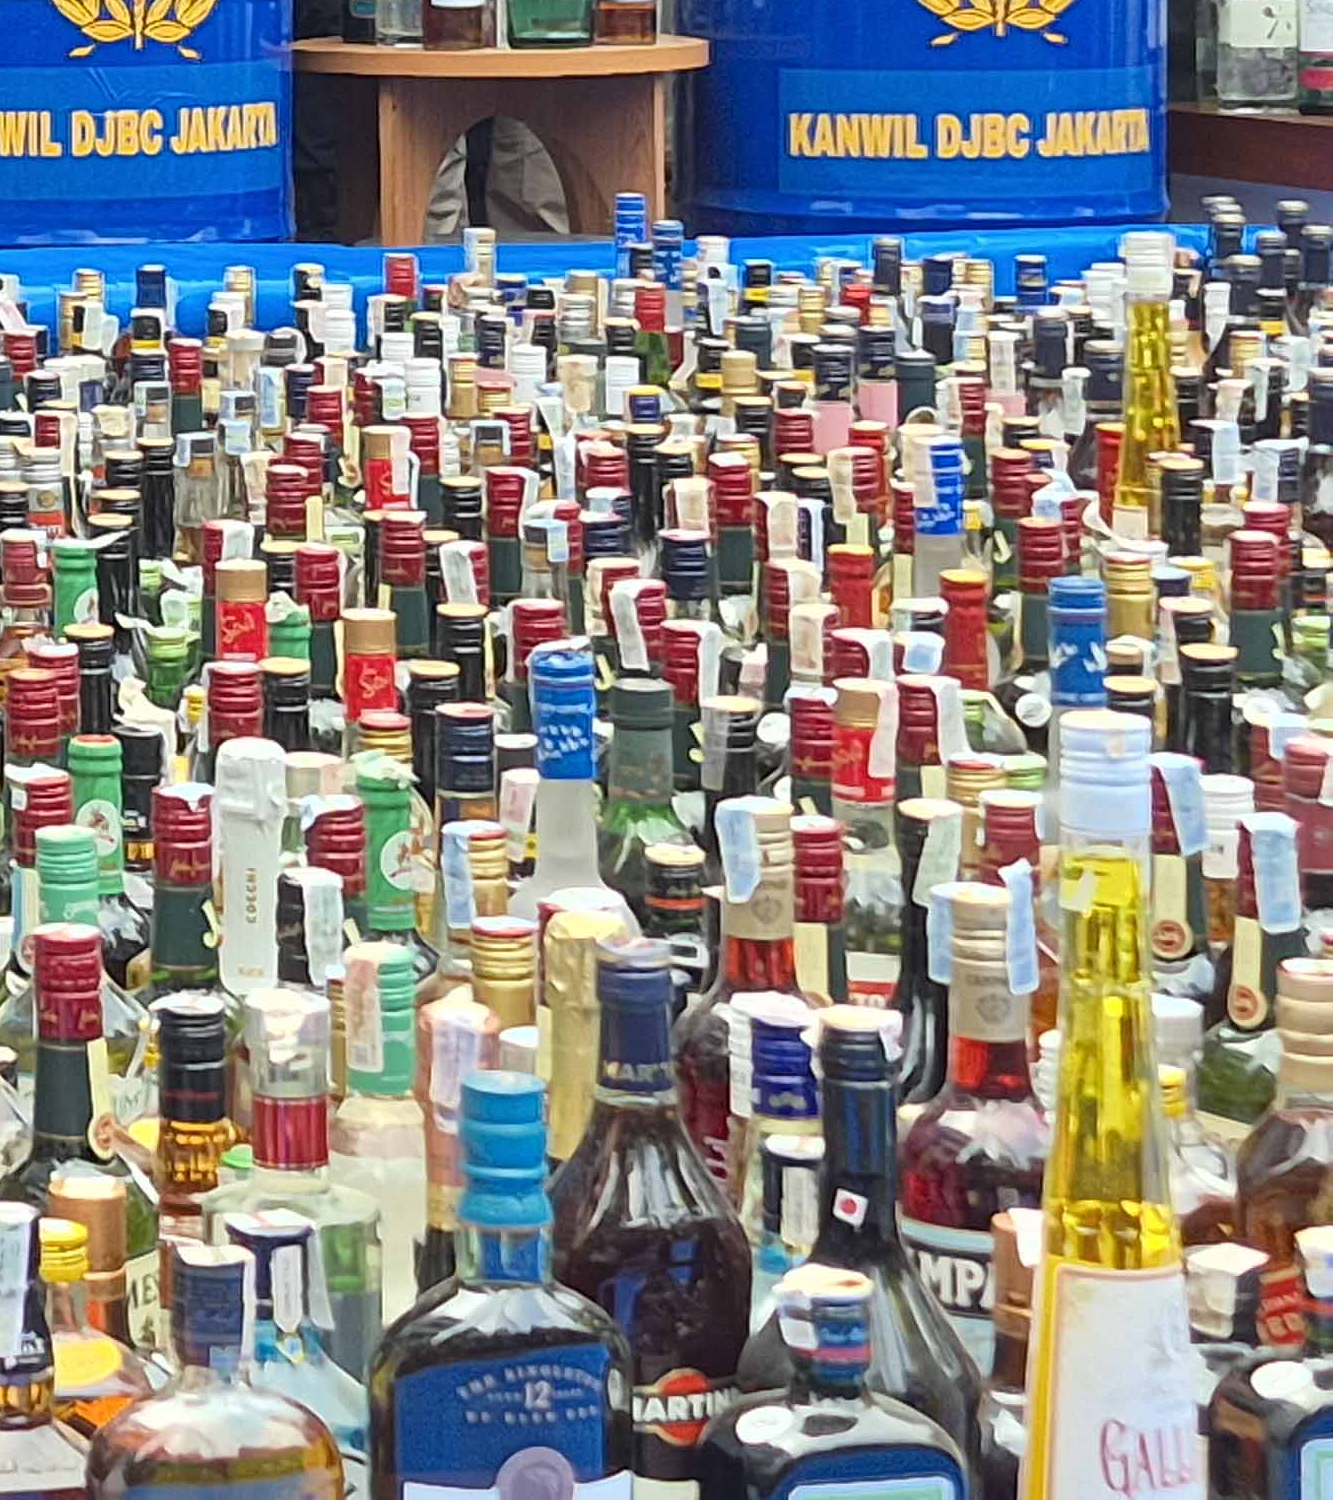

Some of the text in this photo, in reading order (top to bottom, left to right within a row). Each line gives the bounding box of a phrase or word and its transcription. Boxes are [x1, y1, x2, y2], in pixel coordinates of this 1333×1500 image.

[72, 109, 163, 158] DJBC
[171, 102, 278, 154] JAKARTA
[789, 108, 1150, 160] KANWIL DJBC JAKARTA
[524, 1379, 552, 1410] 12
[633, 1388, 737, 1422] ARTIN
